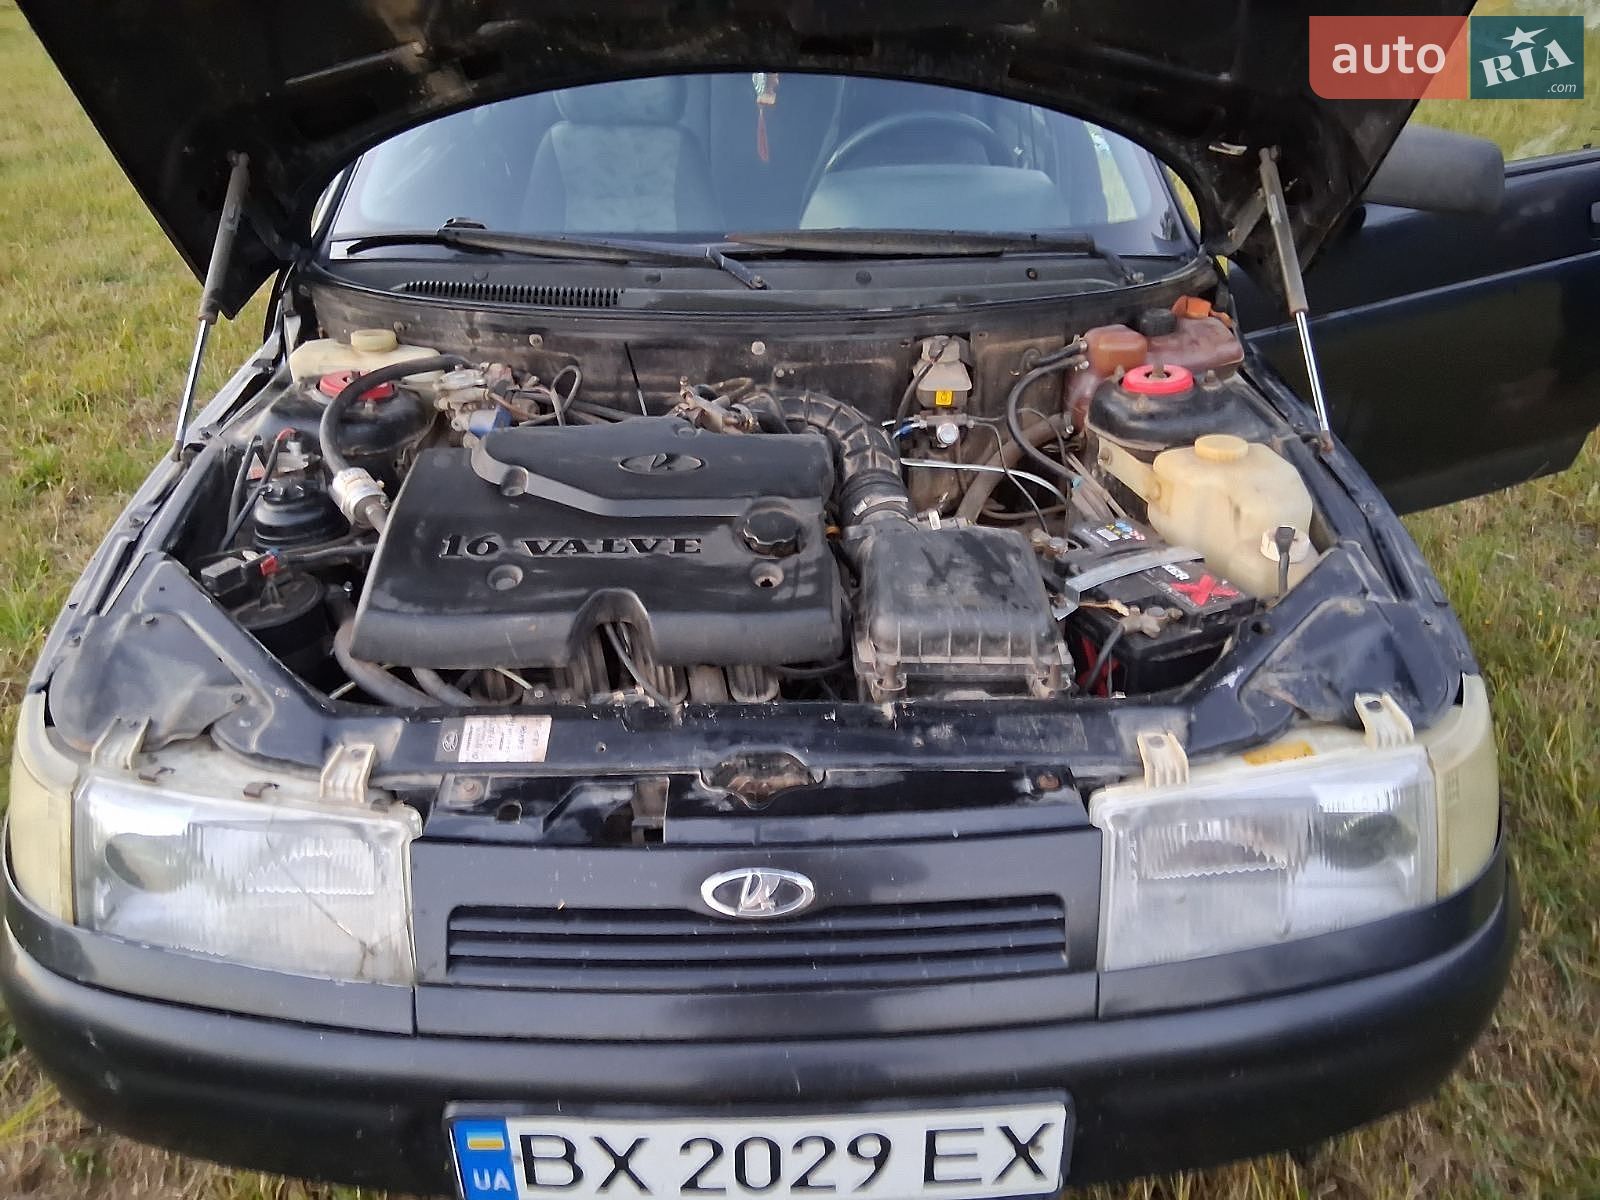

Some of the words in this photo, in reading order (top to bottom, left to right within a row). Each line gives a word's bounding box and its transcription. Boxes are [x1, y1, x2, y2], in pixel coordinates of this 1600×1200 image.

[438, 534, 500, 558] 16
[521, 538, 703, 557] VALVE
[519, 1134, 650, 1193] BX
[679, 1133, 892, 1192] 2029
[923, 1122, 1054, 1185] EX
[473, 1168, 512, 1191] UA
